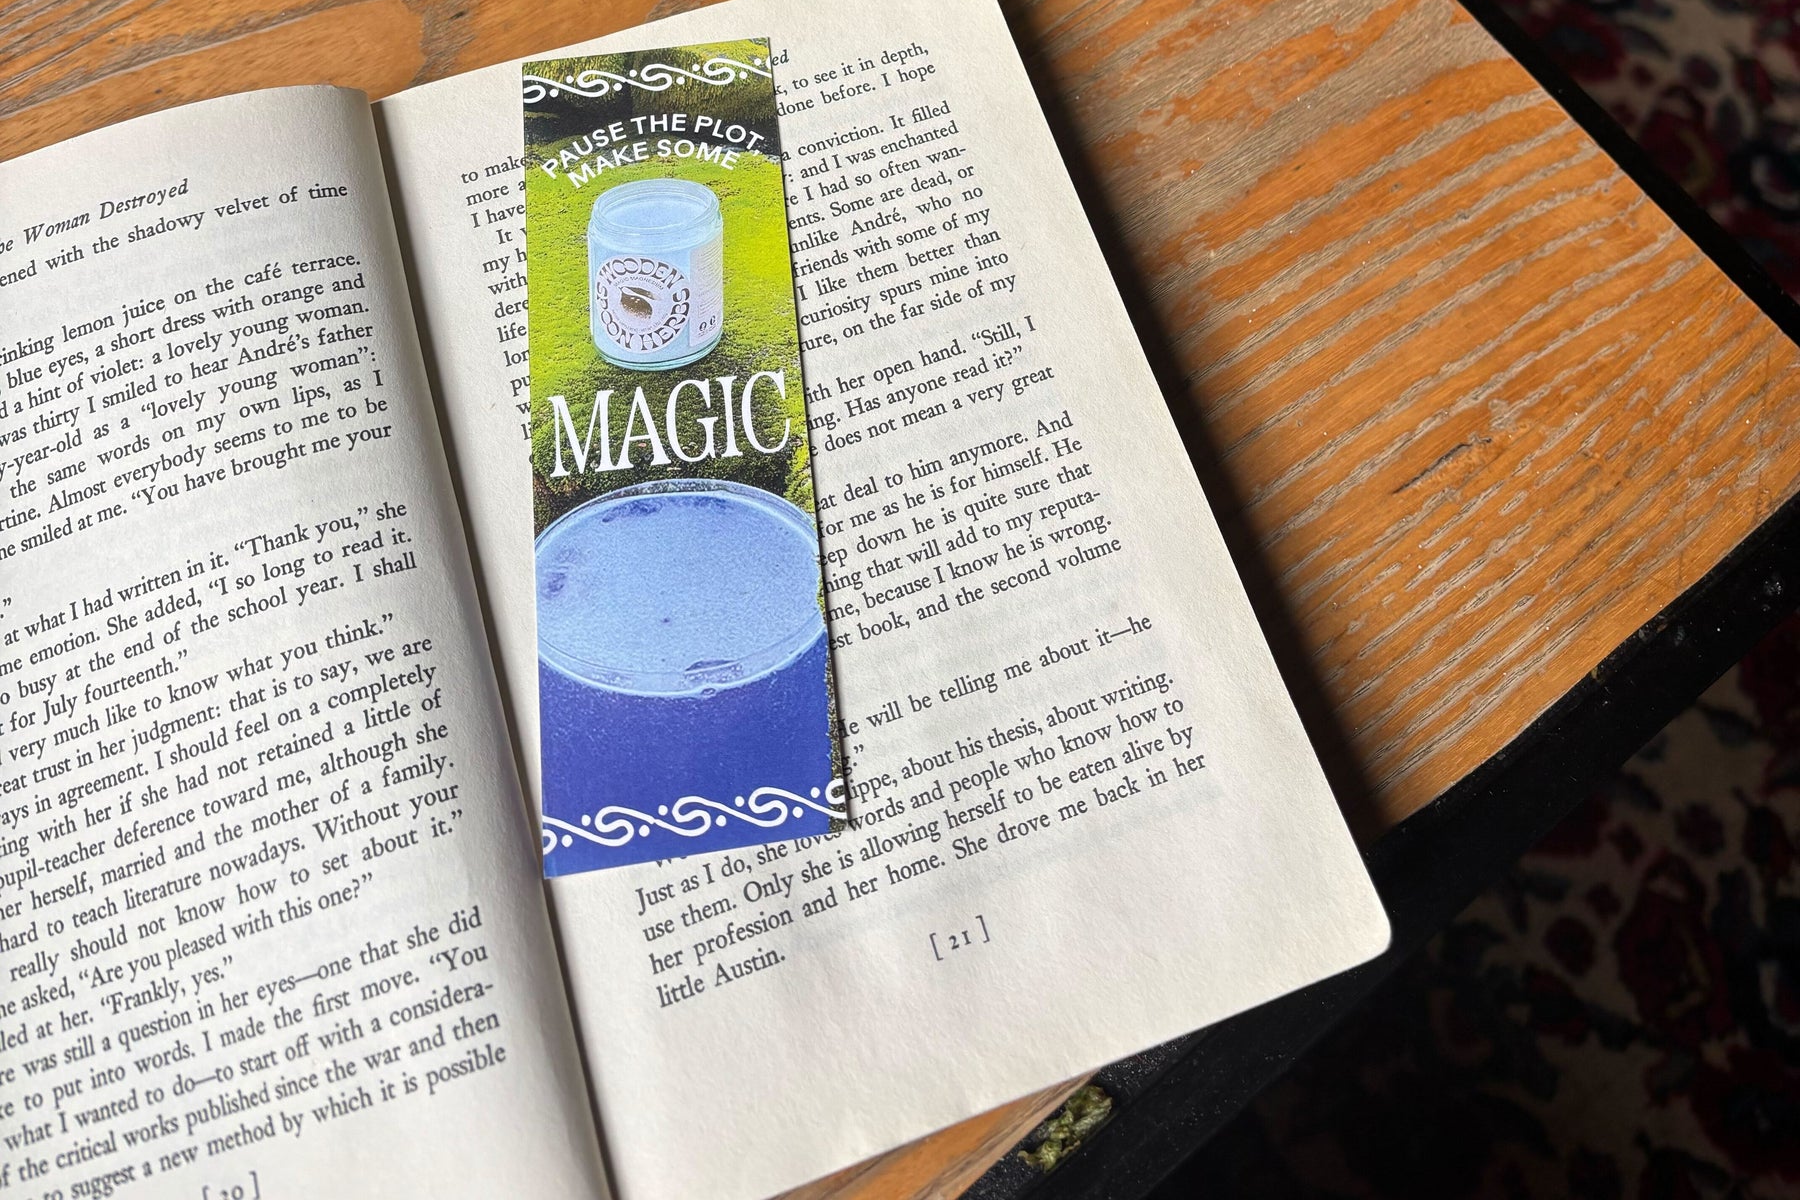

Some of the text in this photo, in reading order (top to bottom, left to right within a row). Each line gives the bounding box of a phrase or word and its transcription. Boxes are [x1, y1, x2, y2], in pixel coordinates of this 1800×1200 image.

[777, 64, 936, 117] done before. I hope
[791, 41, 929, 90] to see it in depth,
[461, 171, 479, 184] to
[541, 113, 764, 180] PAUSE THE PLOT,
[566, 139, 741, 189] MAKE SOME
[22, 177, 189, 245] Woman Destroyed
[44, 182, 349, 270] with the shadowy velvet of time
[465, 185, 510, 206] more
[471, 204, 526, 228] I have
[850, 206, 907, 237] André,
[914, 195, 952, 215] who
[961, 187, 984, 202] no
[482, 255, 511, 274] my
[496, 228, 513, 245] It
[797, 230, 1002, 301] I like them better than
[61, 254, 361, 343] lemon juice on the café terrace.
[488, 272, 528, 296] with
[600, 257, 684, 289] WOODEN
[800, 252, 1009, 326] curiosity spurs mine into
[497, 322, 527, 343] life
[597, 282, 690, 350] SPOON HERBS
[32, 406, 81, 435] thirty
[86, 395, 97, 414] I
[101, 374, 158, 409] smiled
[163, 372, 183, 388] to
[189, 357, 229, 380] hear
[316, 323, 374, 346] father
[835, 374, 866, 395] her
[872, 359, 916, 386] open
[917, 338, 967, 367] hand.
[1023, 314, 1037, 332] I
[9, 368, 384, 499] the same words on my own lips, as I
[547, 369, 791, 477] MAGIC
[843, 409, 1074, 502] deal to him anymore. And
[3, 628, 21, 647] at
[23, 611, 67, 638] what
[68, 601, 79, 621] I
[81, 587, 114, 617] had
[116, 569, 183, 603] written
[186, 559, 206, 579] in
[209, 551, 230, 571] it.
[375, 501, 408, 522] she
[7, 737, 47, 762] very
[53, 713, 101, 747] much
[104, 703, 137, 728] like
[143, 696, 162, 713] to
[166, 674, 219, 704] know
[225, 655, 274, 682] what
[279, 641, 319, 672] you
[865, 700, 905, 728] will
[907, 694, 933, 713] be
[938, 672, 999, 703] telling
[1002, 660, 1033, 681] me
[1038, 638, 1091, 668] about
[29, 752, 455, 911] herself, married and the mother of a family.
[648, 754, 1206, 975] her profession and her home. She drove me back in her
[9, 950, 60, 983] really
[70, 923, 129, 962] should
[137, 916, 167, 940] not
[174, 896, 226, 926] know
[235, 878, 277, 905] how
[289, 868, 310, 886] to
[321, 853, 350, 875] set
[361, 829, 419, 862] about
[655, 947, 786, 1009] little Austin.
[3, 1122, 52, 1151] what
[58, 1111, 68, 1134] I
[74, 1088, 139, 1128] wanted
[145, 1087, 165, 1106] to
[239, 1050, 279, 1076] start
[284, 1032, 310, 1062] off
[317, 1017, 364, 1050] with
[370, 1017, 383, 1033] a
[389, 982, 494, 1027] considera-
